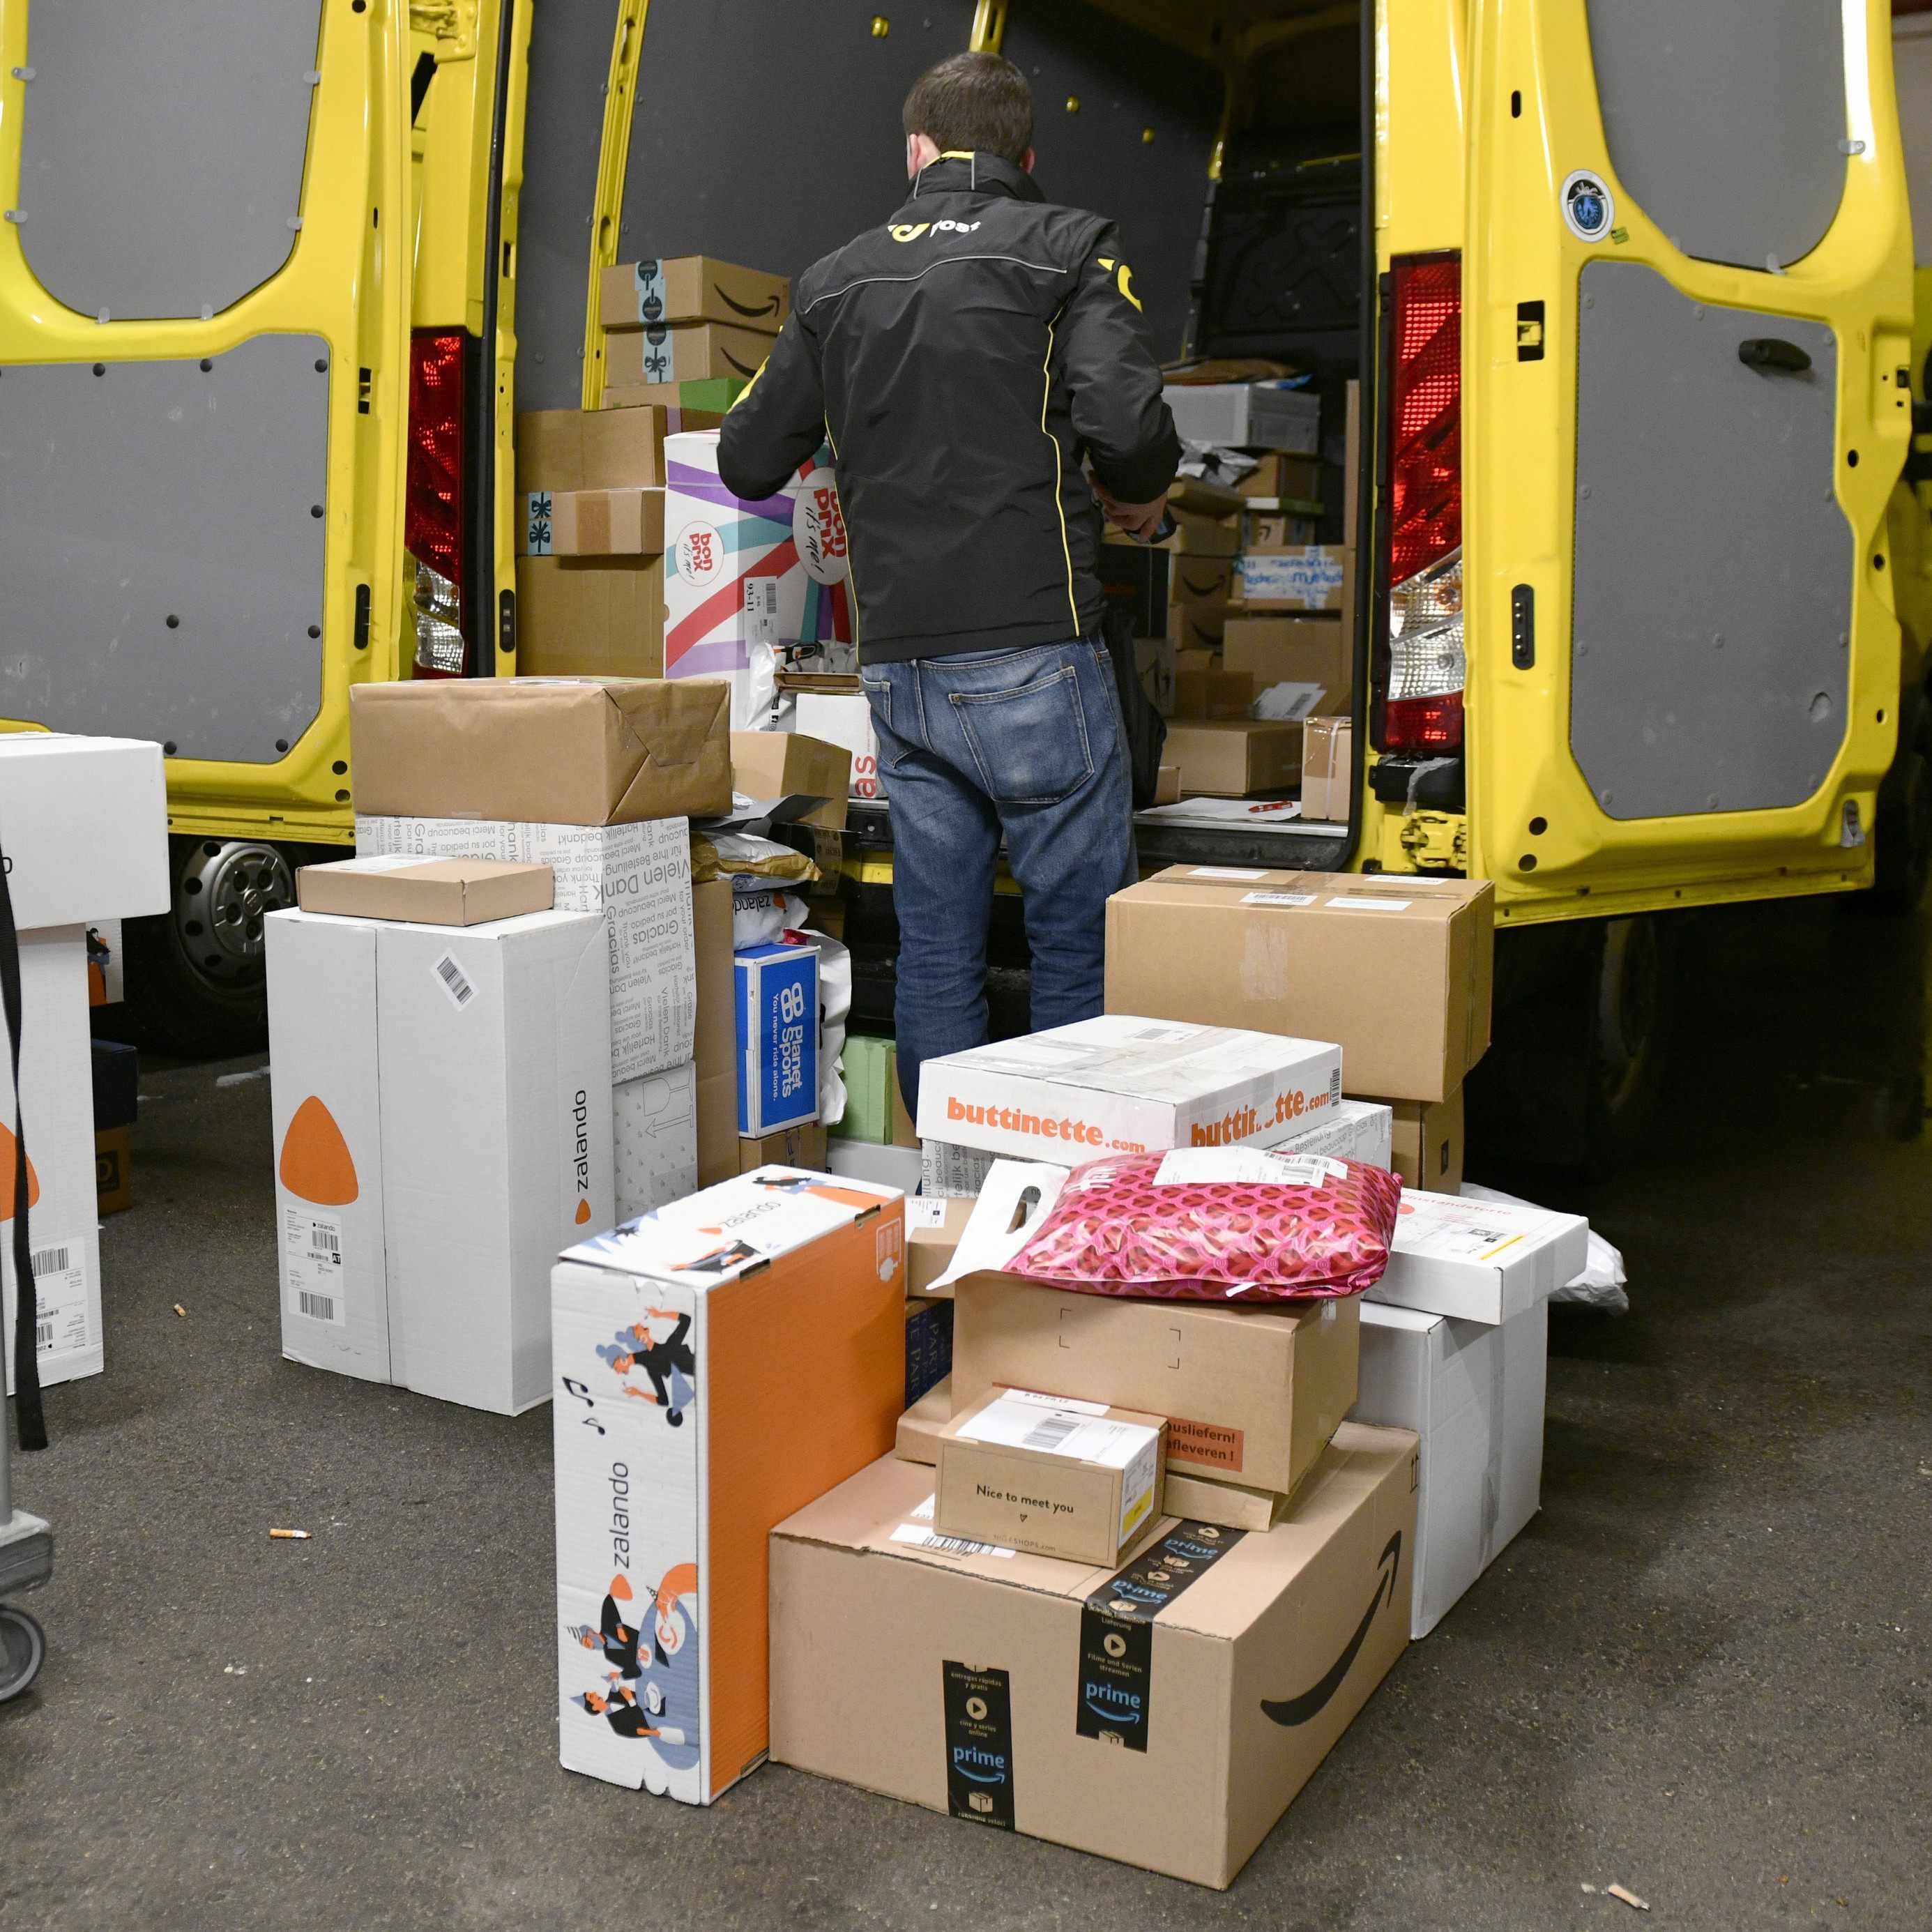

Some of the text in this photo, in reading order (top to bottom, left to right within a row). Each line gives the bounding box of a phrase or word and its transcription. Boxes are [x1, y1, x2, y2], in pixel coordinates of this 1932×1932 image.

[814, 488, 835, 559] prix
[690, 533, 703, 572] prix
[701, 533, 713, 571] bon
[393, 817, 402, 853] rtelijk
[427, 825, 496, 837] Merci beaucoup
[558, 832, 603, 845] bedankt
[471, 841, 480, 849] su
[482, 839, 496, 849] por
[508, 823, 519, 862] hank
[622, 843, 641, 855] Merci
[671, 844, 682, 857] für
[653, 849, 669, 861] Ihre
[555, 874, 570, 883] yo
[644, 858, 690, 885] Vielen
[593, 874, 639, 904] Dank
[618, 892, 677, 918] Merci beaucoup
[657, 912, 664, 920] su
[666, 906, 677, 918] por
[733, 895, 771, 915] zaland
[607, 906, 620, 974] Gracias
[633, 920, 678, 944] Gracias
[658, 962, 683, 975] Gracias
[609, 974, 652, 994] Vielen Dan
[615, 1019, 641, 1034] Gracias
[622, 1034, 655, 1056] Hartelijk
[637, 1054, 656, 1067] Merci
[779, 1028, 792, 1098] Sports
[791, 1025, 803, 1090] Planet
[611, 1063, 635, 1078] beauc
[948, 1097, 1145, 1154] buttinette.com
[572, 1090, 588, 1193] zalando
[952, 1165, 964, 1196] telijk
[317, 1223, 335, 1232] zalando
[977, 1484, 1074, 1514] Nice to meet you
[608, 1462, 630, 1569] zalando
[1088, 1653, 1105, 1663] Filme
[1107, 1658, 1120, 1667] und
[1086, 1682, 1141, 1709] prime
[953, 1747, 1005, 1769] prime
